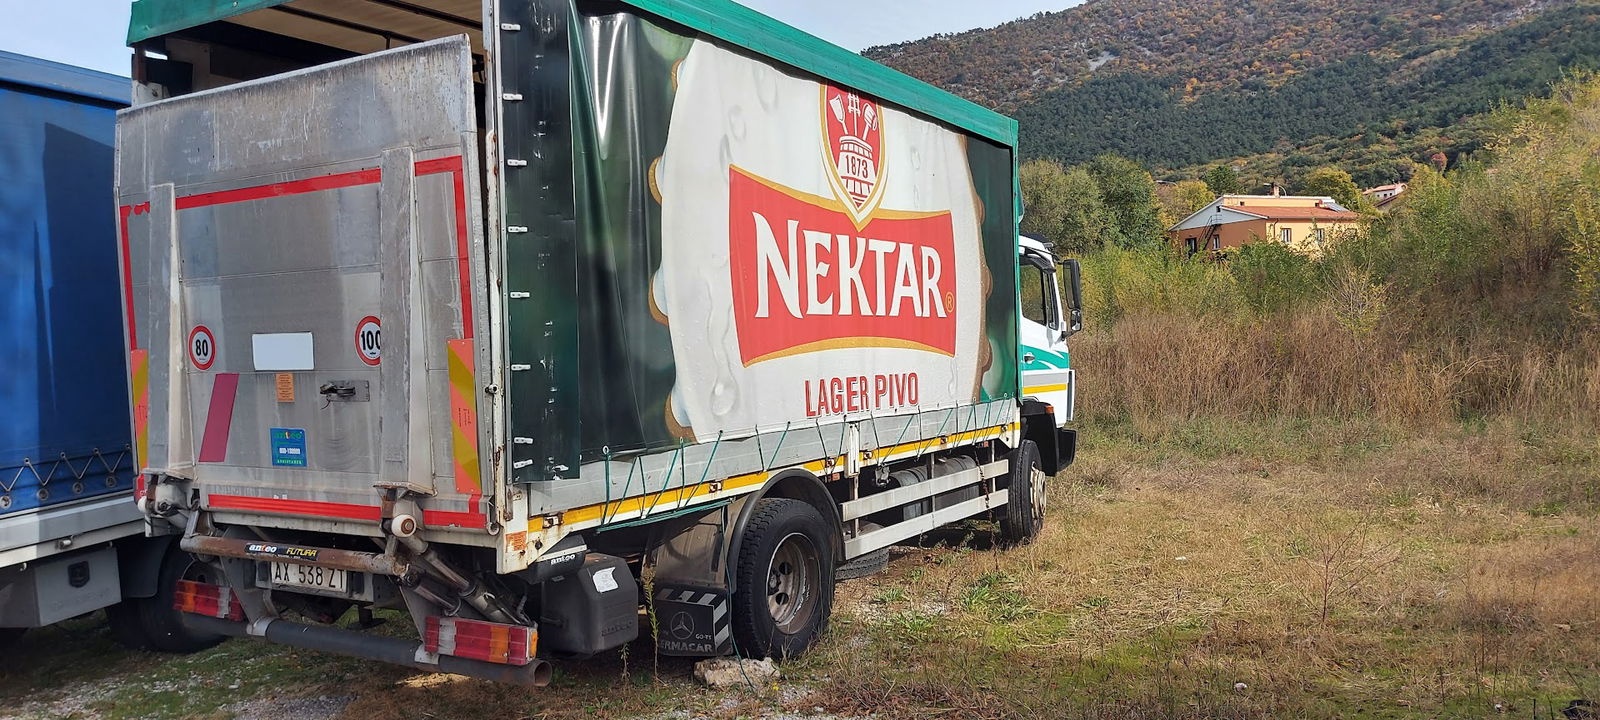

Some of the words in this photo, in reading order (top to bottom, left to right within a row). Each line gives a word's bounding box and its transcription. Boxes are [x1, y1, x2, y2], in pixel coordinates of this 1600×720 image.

[845, 154, 868, 179] 1873
[752, 212, 947, 319] NEKTAR
[195, 339, 209, 357] 80
[361, 330, 381, 350] 100
[805, 375, 870, 418] LAGER
[874, 371, 919, 408] PIVO
[249, 544, 277, 553] anteo
[286, 547, 317, 557] FUTURA
[275, 562, 290, 581] AX
[298, 564, 323, 586] 538
[328, 567, 345, 588] ZT
